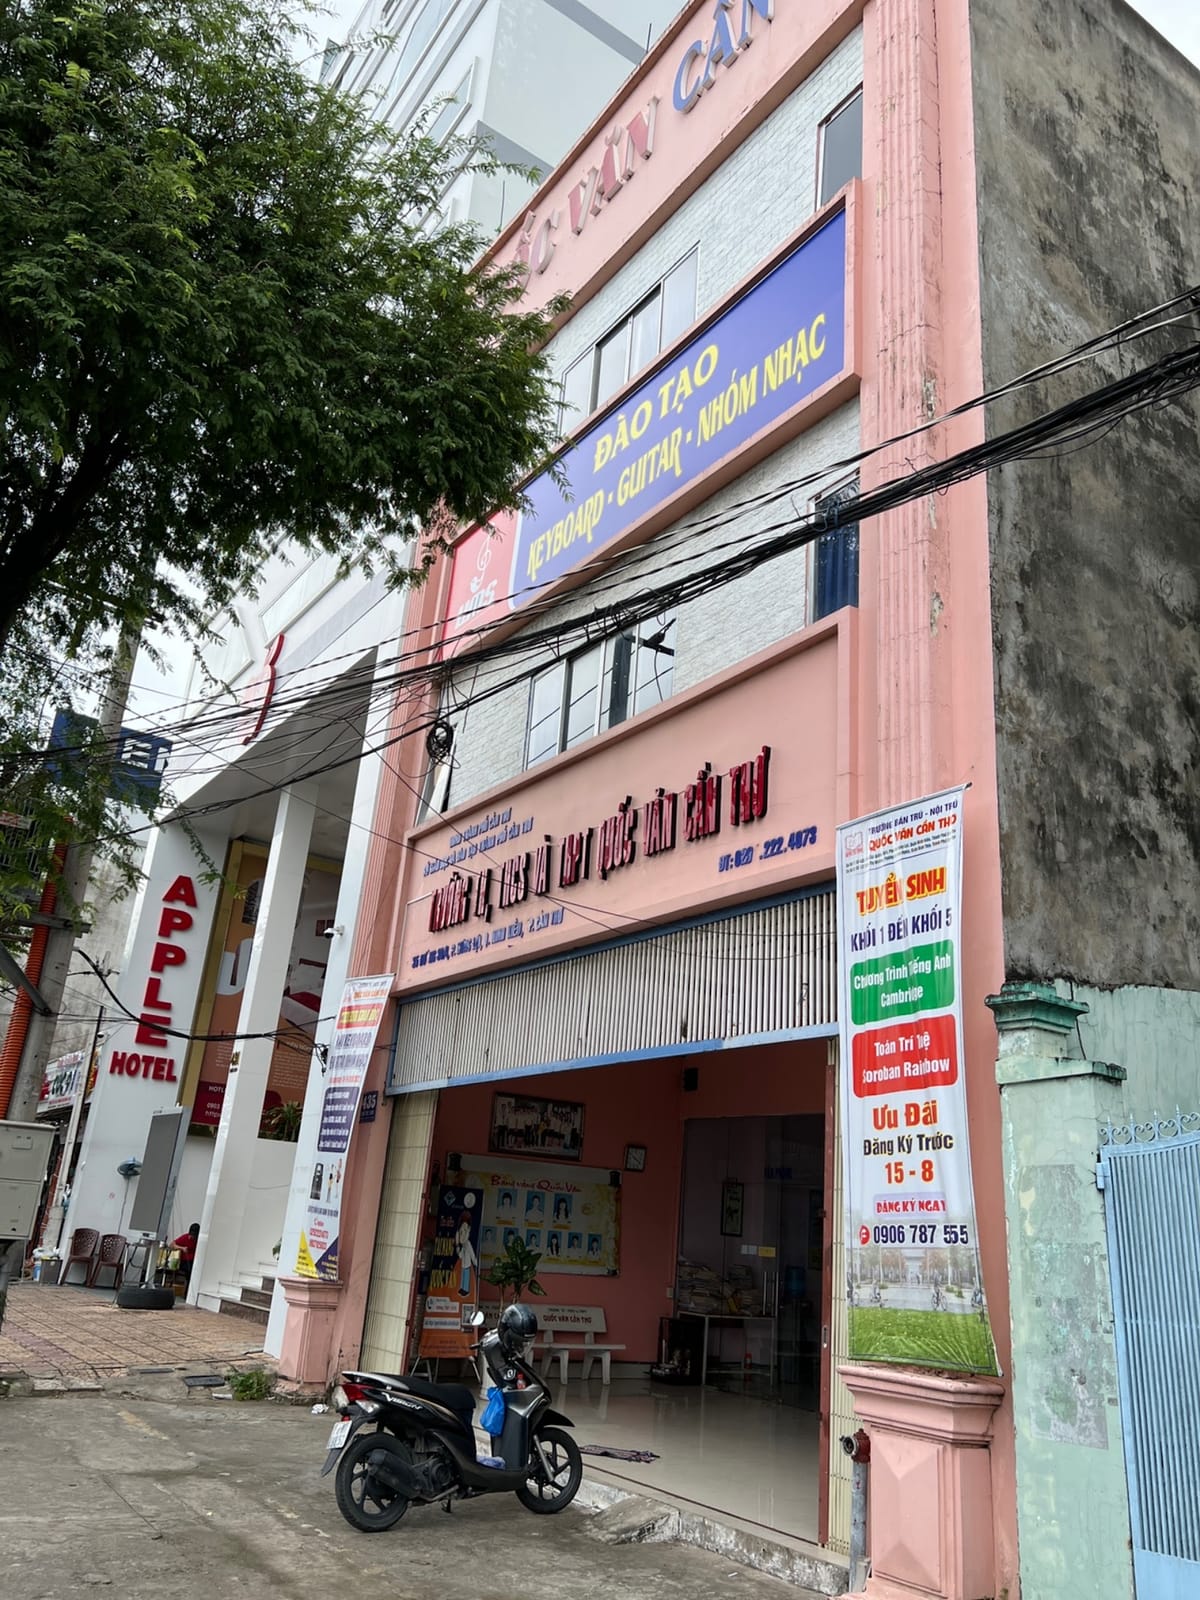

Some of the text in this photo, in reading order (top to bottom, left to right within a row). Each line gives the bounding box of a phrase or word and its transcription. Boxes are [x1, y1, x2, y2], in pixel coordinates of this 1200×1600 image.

[568, 96, 660, 236] VĂN
[593, 344, 719, 473] ĐÀO TẠO
[527, 490, 604, 581] KEYBOARD
[617, 427, 682, 507] GUITAR
[697, 366, 757, 448] NHÓM
[762, 313, 826, 398] NHẠC
[596, 796, 638, 880] QUỐC
[683, 762, 722, 841] CẦN
[729, 745, 771, 826] THƠ
[869, 834, 892, 852] QUỐC
[856, 866, 947, 917] TUYỂN SINH
[851, 922, 876, 952] KHỐI
[880, 927, 885, 945] 1
[912, 904, 942, 935] KHỐI
[946, 908, 952, 927] 5
[135, 875, 198, 1047] APPLE
[934, 954, 951, 970] Anh
[874, 1041, 896, 1057] Toán
[899, 1036, 914, 1052] Trí
[109, 1051, 177, 1083] HOTEL
[208, 1085, 224, 1093] HOTL
[873, 1100, 938, 1130] Ưu Đãi
[863, 1131, 954, 1156] Đăng Ký Trước
[884, 1161, 905, 1184] 15
[921, 1159, 934, 1182] 8
[902, 1197, 916, 1213] KÝ
[873, 1224, 969, 1245] 0906 787 555
